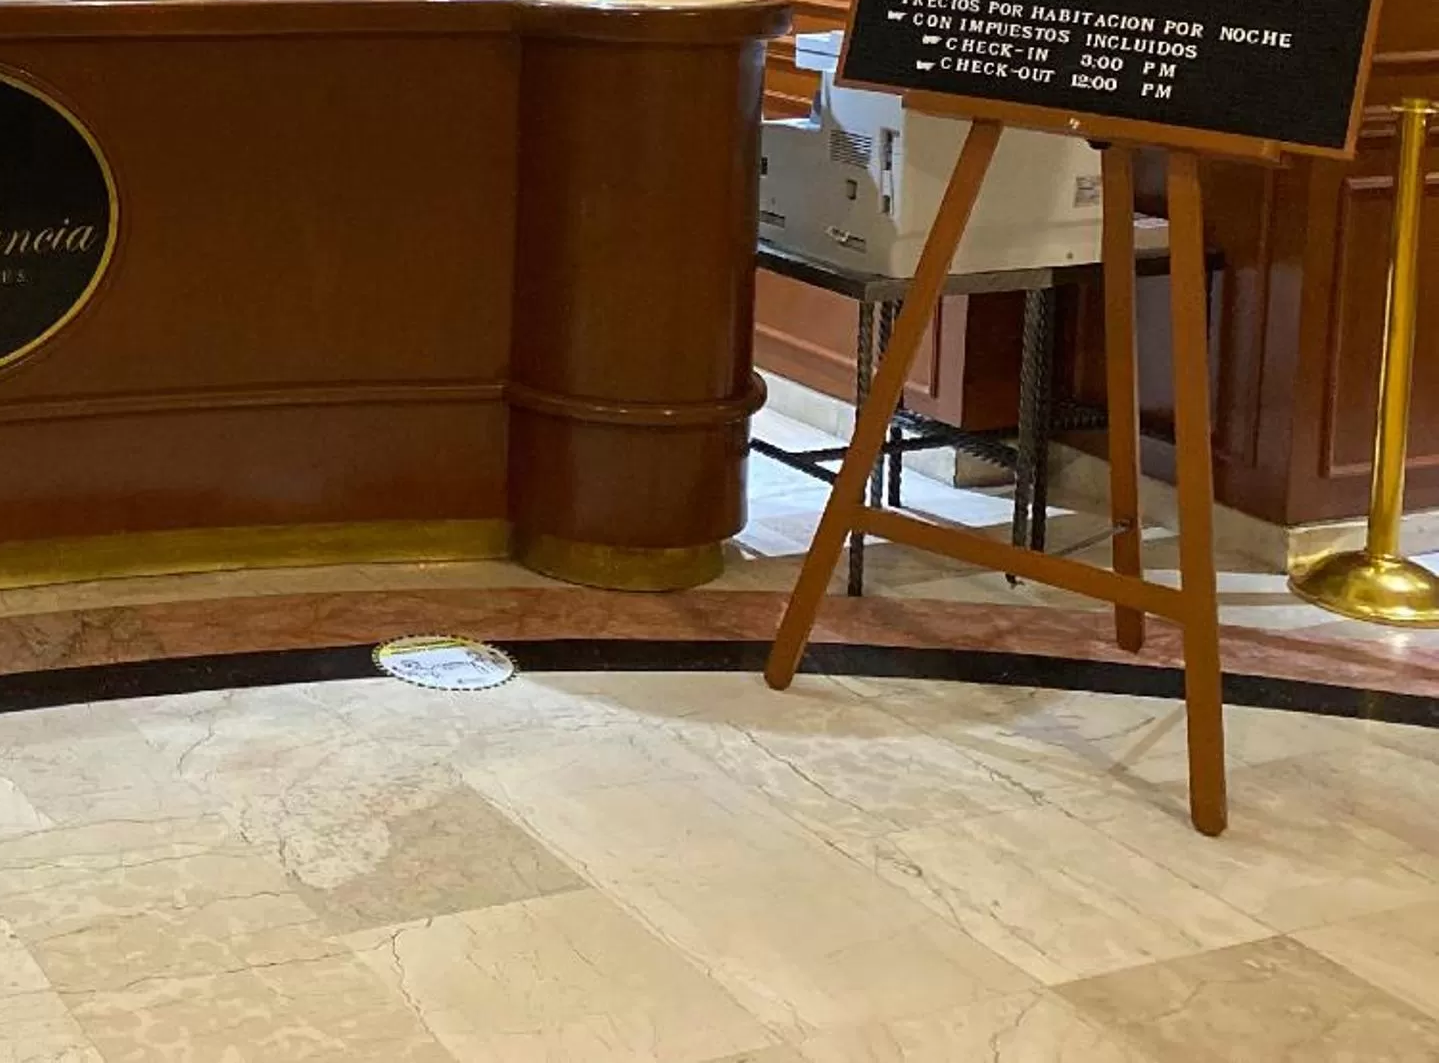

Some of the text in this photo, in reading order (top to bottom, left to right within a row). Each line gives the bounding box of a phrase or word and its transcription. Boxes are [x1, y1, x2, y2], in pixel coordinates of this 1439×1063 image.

[913, 13, 1198, 59] CON IMPUESTOS INCLUIDOS
[988, 0, 1024, 18] POR
[1030, 5, 1155, 33] HABITACION
[1164, 20, 1205, 38] POR
[1219, 26, 1293, 49] NOCHE
[945, 37, 1050, 62] CHECK-IN
[940, 57, 1056, 83] CHECK-OUT
